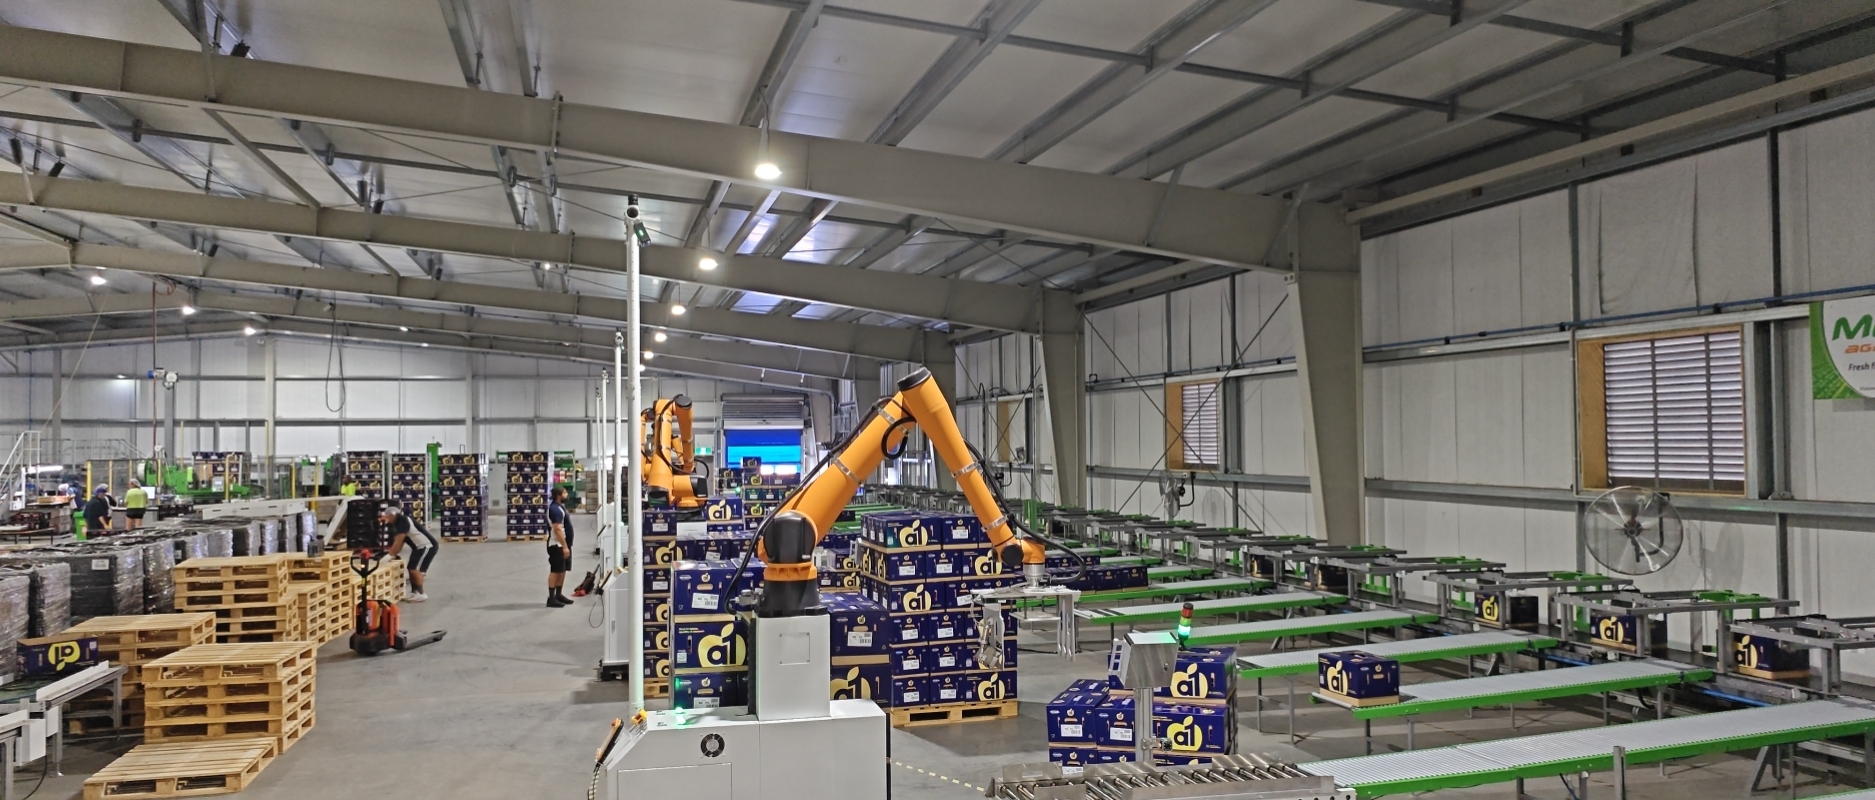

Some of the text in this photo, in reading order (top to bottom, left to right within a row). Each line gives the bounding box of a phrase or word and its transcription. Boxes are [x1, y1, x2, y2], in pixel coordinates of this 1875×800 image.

[1832, 314, 1875, 341] M
[1848, 362, 1870, 371] Fresh
[713, 503, 726, 519] a1
[905, 527, 922, 545] a1
[909, 591, 925, 610] a1
[1604, 621, 1618, 641] a1
[707, 634, 736, 665] a1
[983, 681, 999, 699] a1
[1177, 672, 1200, 696] a1
[1331, 669, 1343, 693] a1
[1174, 725, 1195, 746] a1
